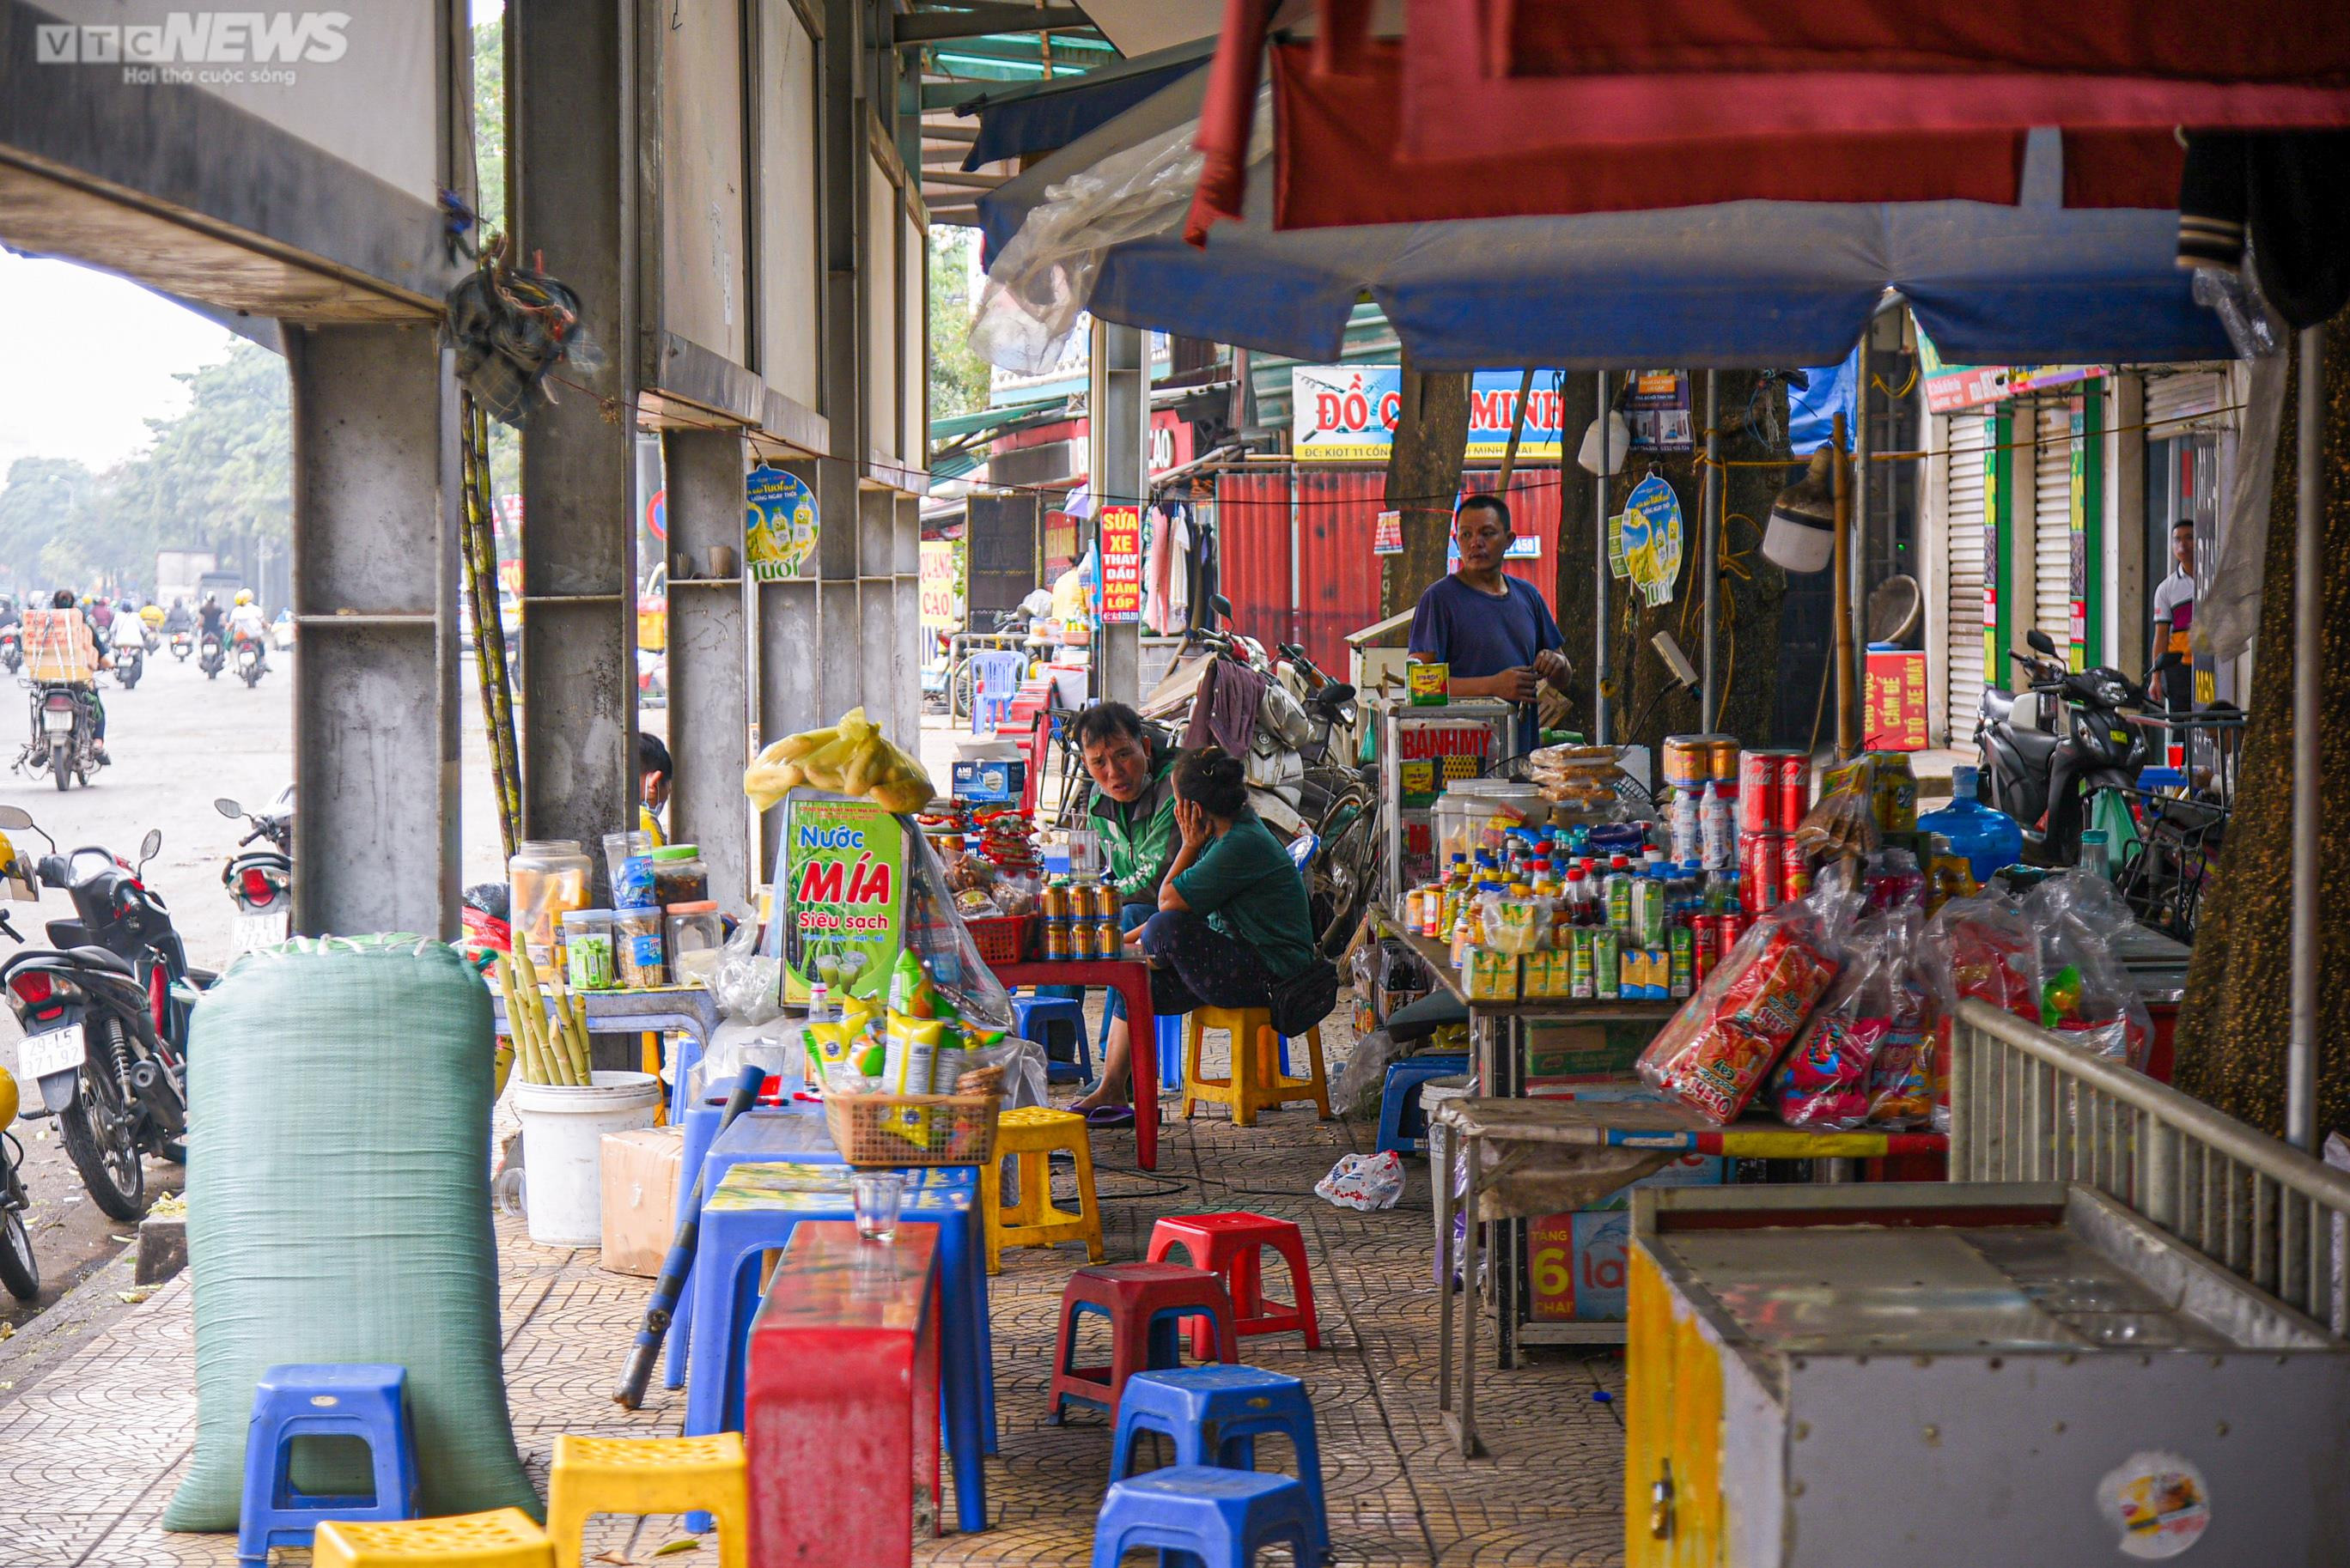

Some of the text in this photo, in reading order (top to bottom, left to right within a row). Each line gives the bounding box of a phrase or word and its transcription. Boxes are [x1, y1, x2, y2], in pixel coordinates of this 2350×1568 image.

[1316, 373, 1368, 430] ĐỒ
[1470, 391, 1564, 429] MINH
[1325, 447, 1349, 457] KIOT
[1474, 446, 1503, 454] MINH
[1103, 507, 1138, 531] SỬA
[1110, 535, 1133, 552] XE
[1104, 554, 1138, 565] THAY
[1903, 657, 1924, 686] MÁY
[1907, 689, 1924, 705] XE
[800, 824, 864, 848] Nước
[797, 852, 891, 904] MÍA
[799, 911, 889, 933] Siêu sạch
[1712, 1058, 1736, 1081] Cay
[1532, 1248, 1569, 1296] 6
